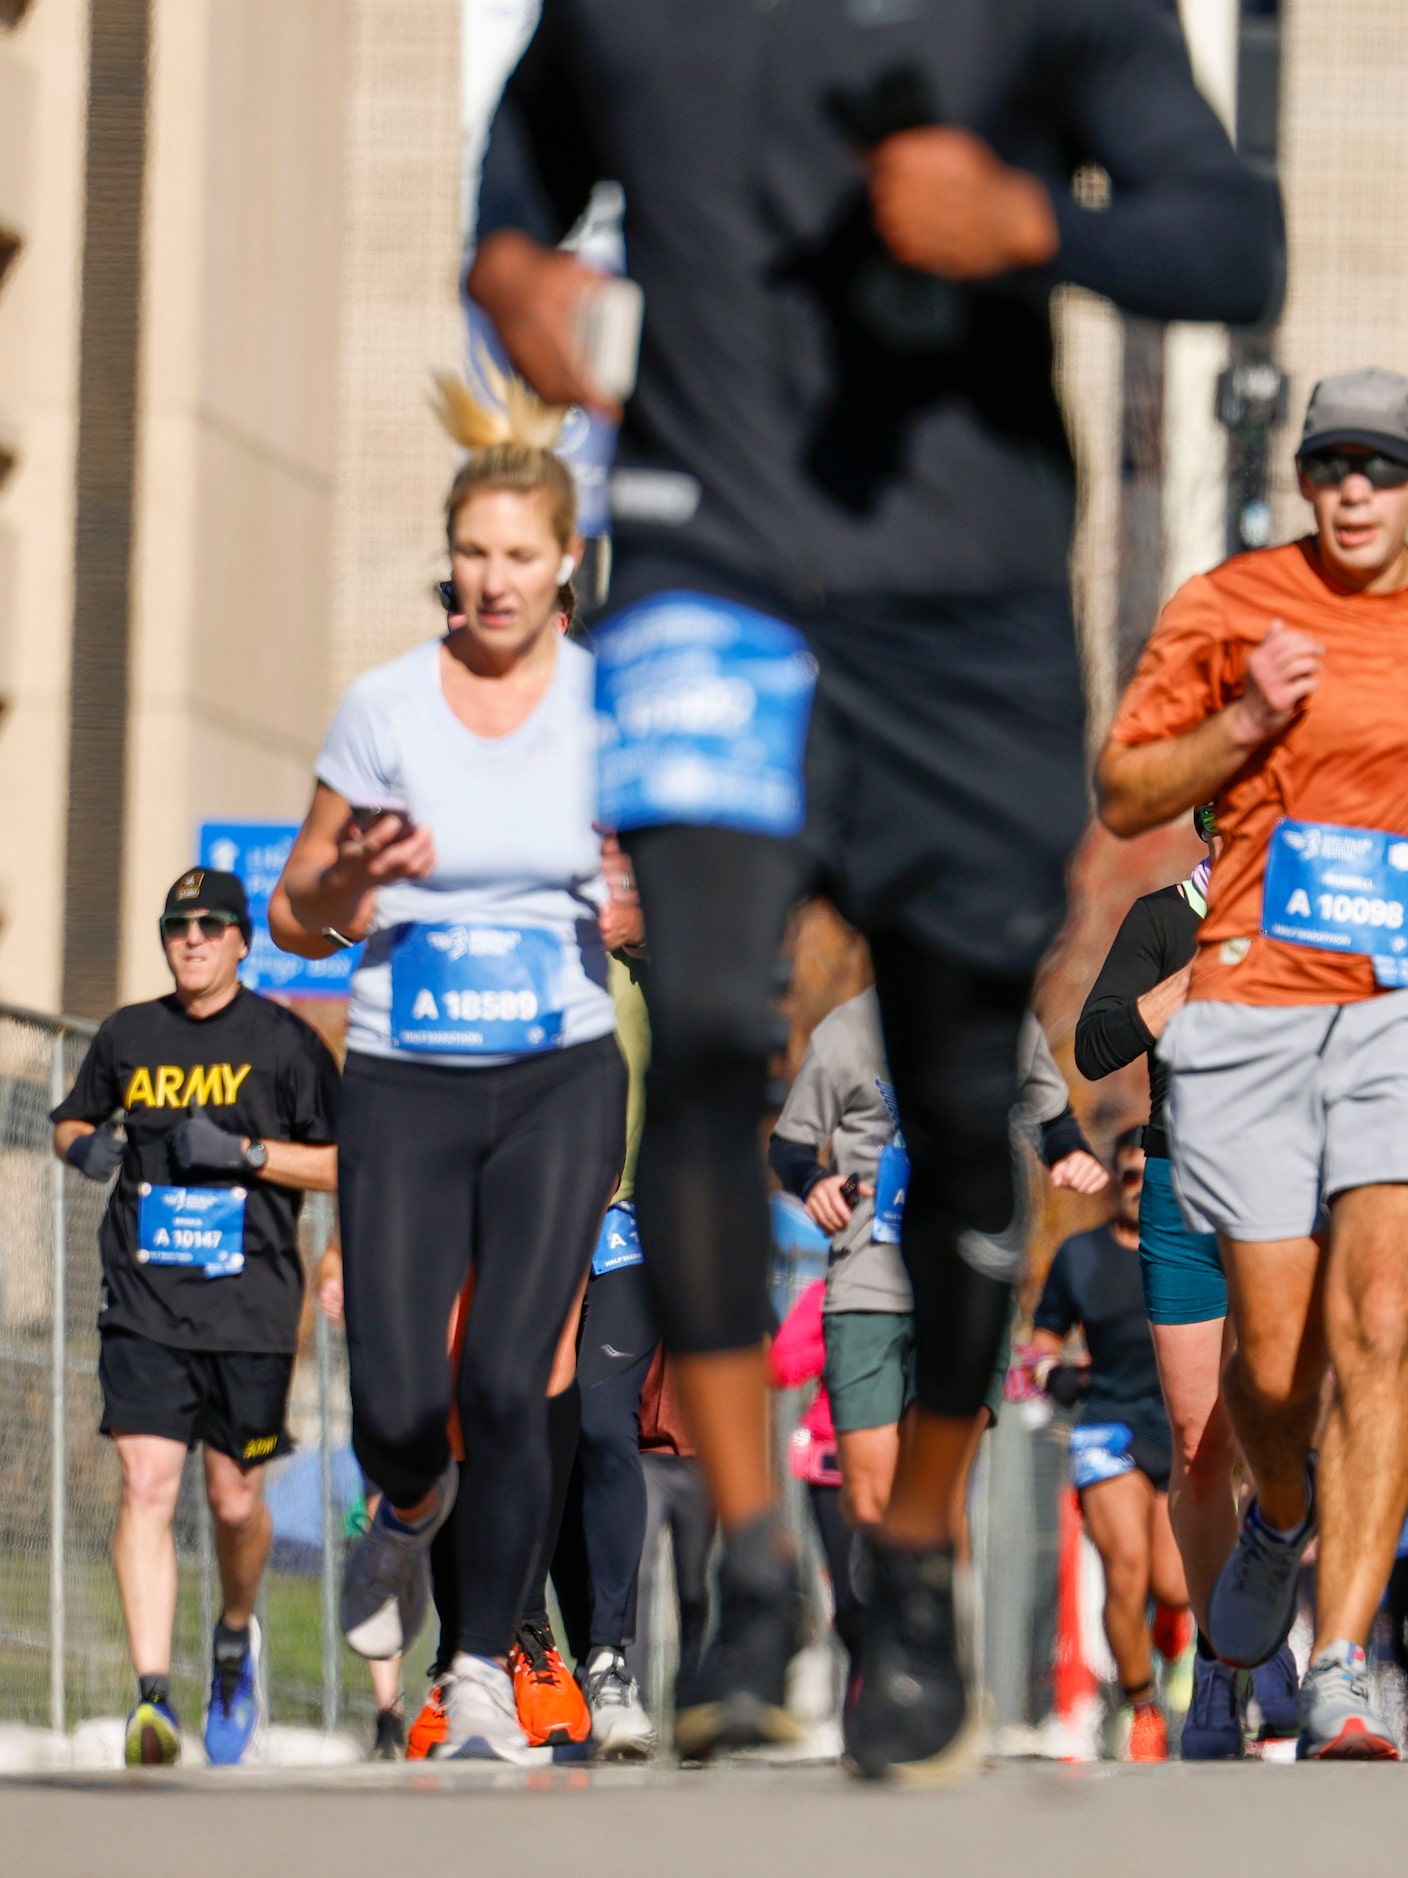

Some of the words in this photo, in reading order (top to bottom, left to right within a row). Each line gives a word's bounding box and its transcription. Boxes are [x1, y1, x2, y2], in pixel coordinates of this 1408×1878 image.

[1285, 888, 1311, 918] A
[1318, 893, 1405, 929] 10098
[412, 988, 440, 1020] A
[124, 1063, 252, 1109] ARMY
[154, 1227, 170, 1247] A
[172, 1229, 223, 1249] 10147
[610, 1232, 627, 1249] A
[605, 1255, 620, 1267] HALF
